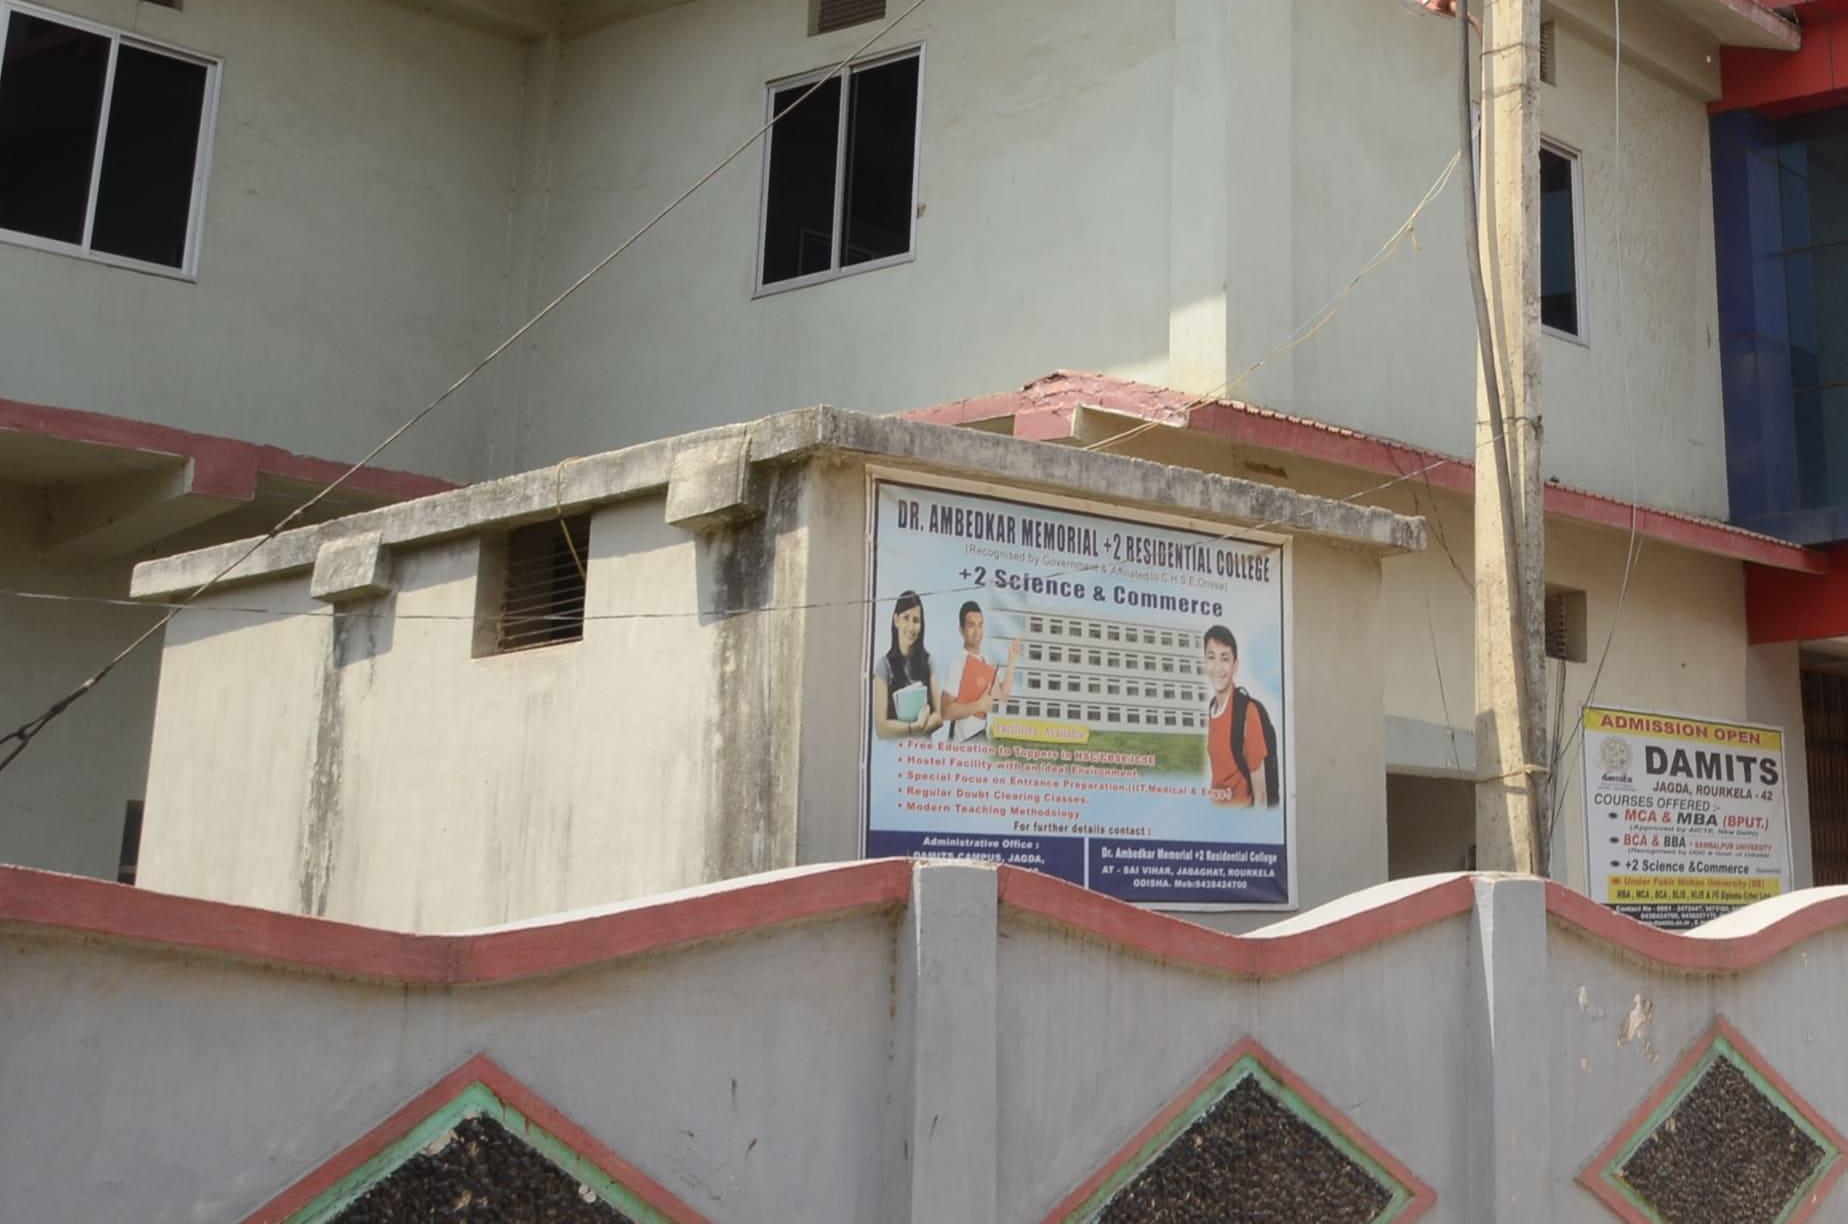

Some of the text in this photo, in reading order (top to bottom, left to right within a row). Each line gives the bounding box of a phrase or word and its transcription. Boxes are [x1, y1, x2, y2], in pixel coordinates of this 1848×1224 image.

[898, 499, 1270, 582] DR. AMBEDKAR MEMORIAL +2 RESIDENTIAL COLLEGE
[965, 544, 1025, 562] (Recognised
[1029, 551, 1040, 566] by
[959, 566, 1223, 617] +2 Science & Commerce
[1601, 714, 1760, 745] ADMISSION OPEN
[907, 740, 933, 750] Free
[937, 742, 995, 755] Education
[998, 745, 1011, 756] to
[1013, 745, 1058, 760] Toppers
[907, 756, 946, 767] Hostel
[950, 757, 992, 771] Facility
[997, 761, 1020, 772] with
[1024, 764, 1038, 773] an
[1645, 745, 1778, 785] DAMITS
[907, 771, 950, 783] Special
[955, 773, 989, 784] Focus
[992, 776, 1006, 785] on
[1010, 776, 1059, 788] Entrance
[1190, 787, 1197, 795] &
[1653, 781, 1692, 796] JAGDA,
[1696, 785, 1753, 800] ROURKELA
[1761, 789, 1773, 801] 42
[906, 786, 951, 798] Regular
[956, 788, 989, 799] Doubt
[994, 790, 1040, 803] Clearing
[1594, 793, 1654, 808] COURSES
[1657, 797, 1710, 812] OFFERED
[906, 801, 1080, 819] Modern Teaching Methodology
[1624, 808, 1657, 823] MCA
[1661, 811, 1671, 823] &
[1677, 812, 1718, 827] MBA
[1013, 820, 1029, 832] For
[1033, 821, 1068, 833] further
[1072, 824, 1105, 835] details
[1108, 826, 1145, 836] contact
[923, 836, 999, 849] Administrative
[1002, 839, 1033, 849] Office
[1623, 833, 1647, 847] BCA
[1651, 834, 1660, 847] &
[1663, 836, 1686, 848] BBA
[1008, 853, 1045, 864] JAGDA,
[1101, 846, 1278, 866] Dr. Ambedkar Memorial +2 Residential College
[1101, 865, 1115, 874] AT
[1123, 865, 1139, 875] SAI
[1227, 868, 1276, 878] ROURKELA
[1625, 859, 1639, 872] +2
[1642, 859, 1685, 873] Science
